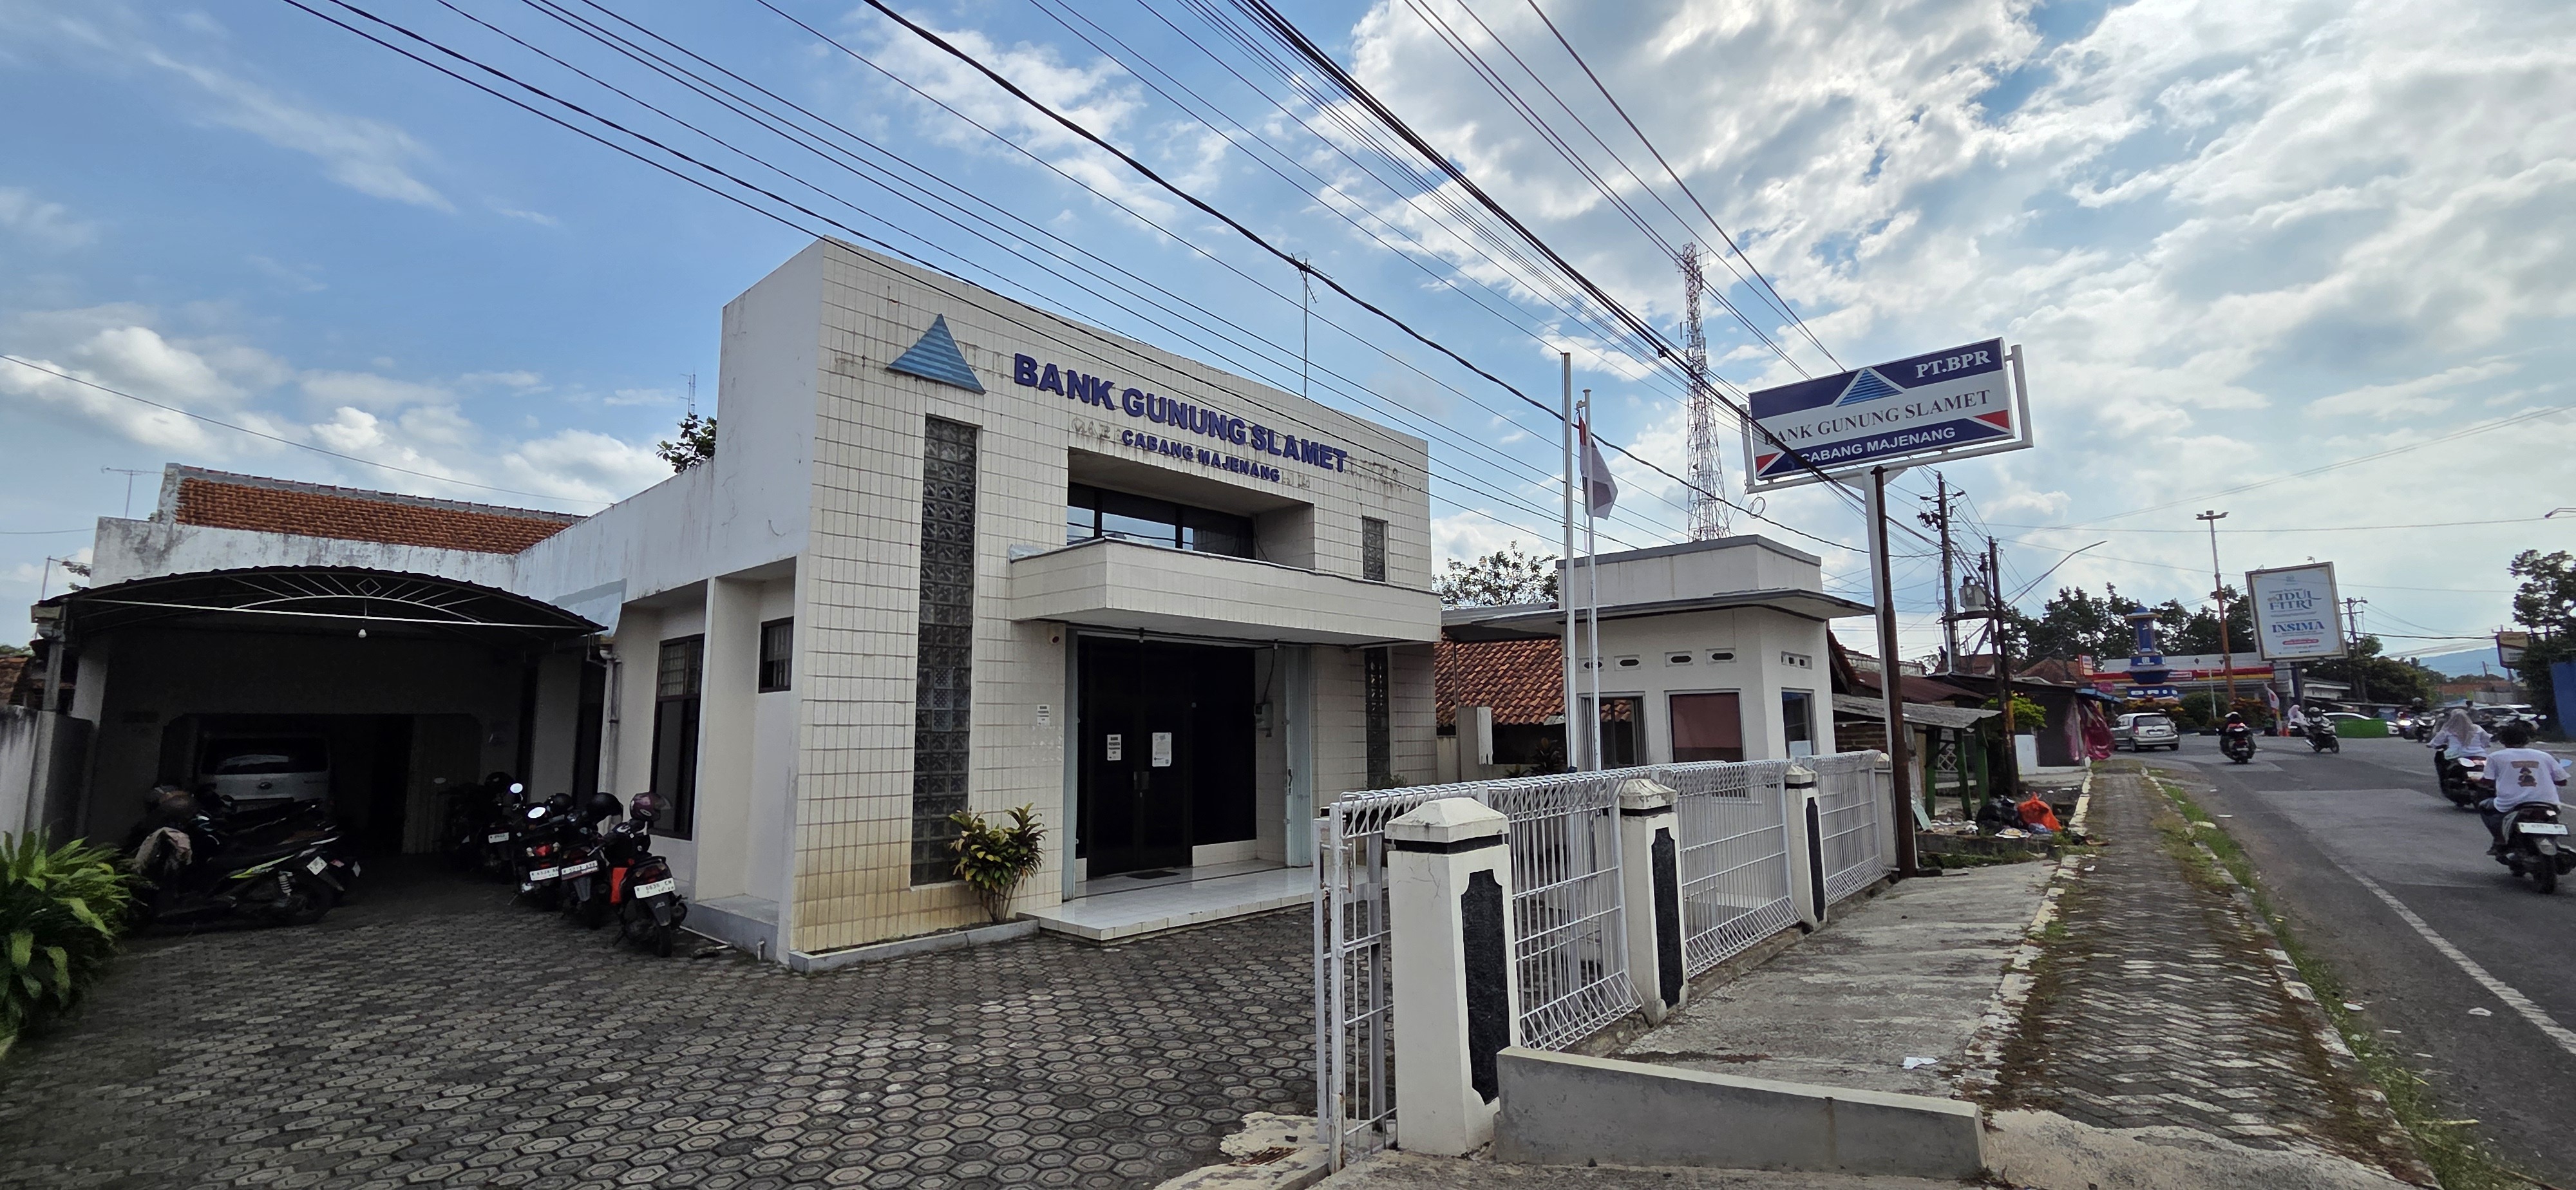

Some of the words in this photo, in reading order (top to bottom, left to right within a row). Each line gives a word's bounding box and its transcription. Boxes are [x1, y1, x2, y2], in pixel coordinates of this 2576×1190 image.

[1915, 350, 1991, 379] PT.BPR
[1014, 352, 1115, 411] BANK
[1122, 387, 1247, 446] GUNUNG
[1251, 423, 1348, 473] SLAMET
[1817, 407, 1899, 435] GUNUNG
[1905, 389, 1991, 419] SLAMET
[1866, 427, 1956, 452] MAJENANG
[1121, 430, 1194, 460] CABANG
[1197, 448, 1280, 482] MAJENANG
[2269, 599, 2313, 610] FITRI
[2275, 589, 2322, 601] IDUL
[2271, 621, 2325, 633] INSIMA
